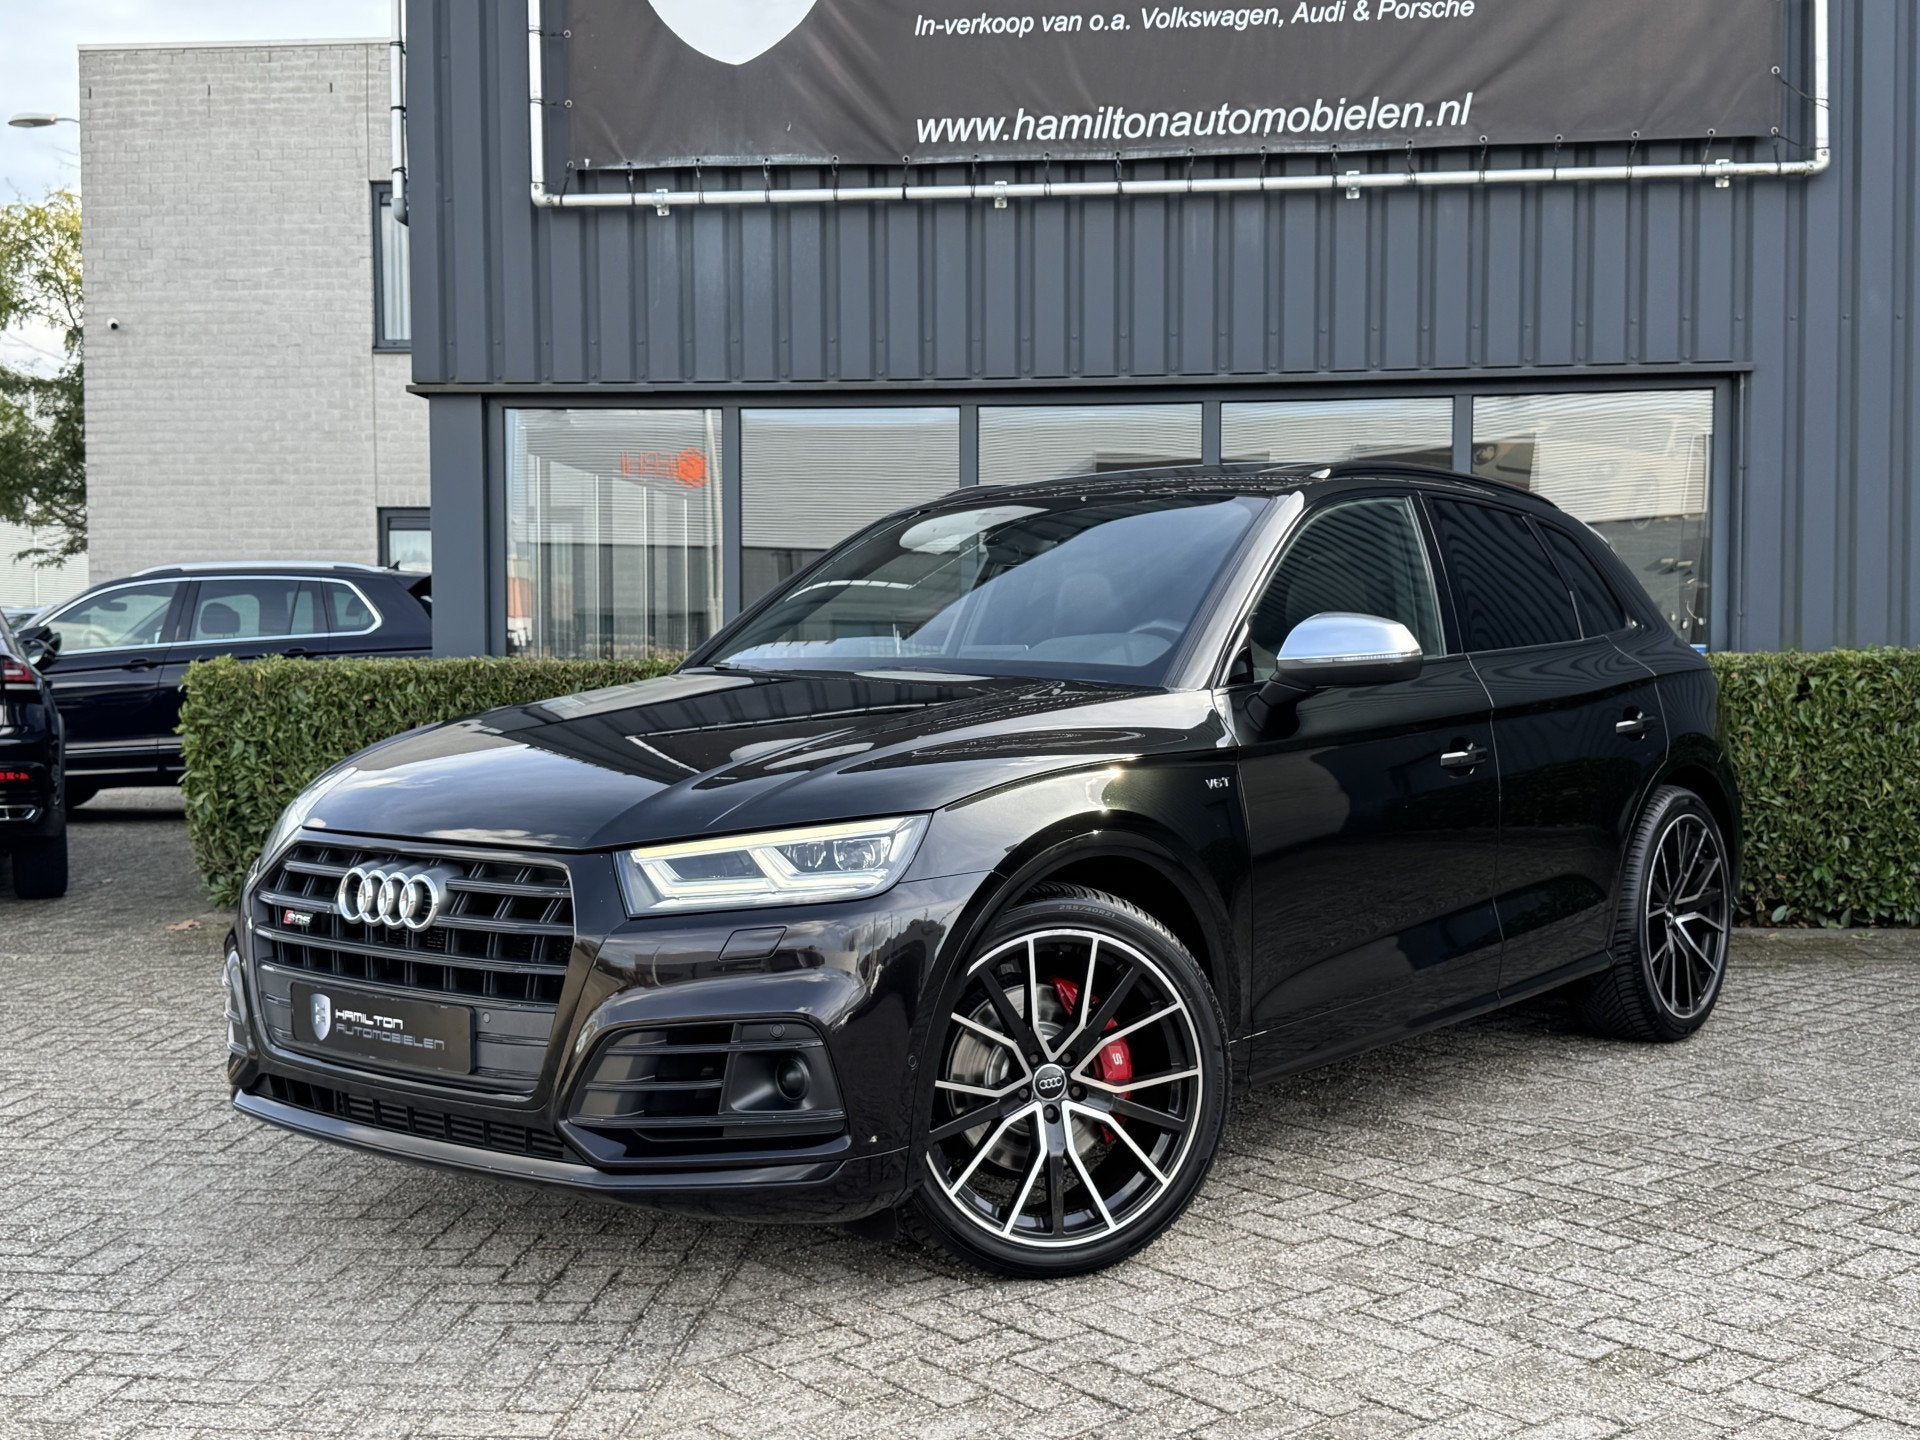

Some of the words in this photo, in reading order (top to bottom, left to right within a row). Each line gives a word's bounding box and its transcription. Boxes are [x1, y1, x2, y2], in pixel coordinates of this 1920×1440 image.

[914, 13, 1035, 38] In-verkoop
[1041, 14, 1083, 32] van
[1089, 13, 1131, 31] o.a.
[1141, 6, 1284, 31] Volkswagen,
[1291, 0, 1347, 23] Audi
[1352, 0, 1370, 21] &
[1377, 0, 1475, 20] Porsche
[916, 91, 1474, 143] www.hamiltonautomobielen.nl
[335, 1008, 404, 1031] HAMILTON
[335, 1022, 445, 1051] AUTOMOBIELEN
